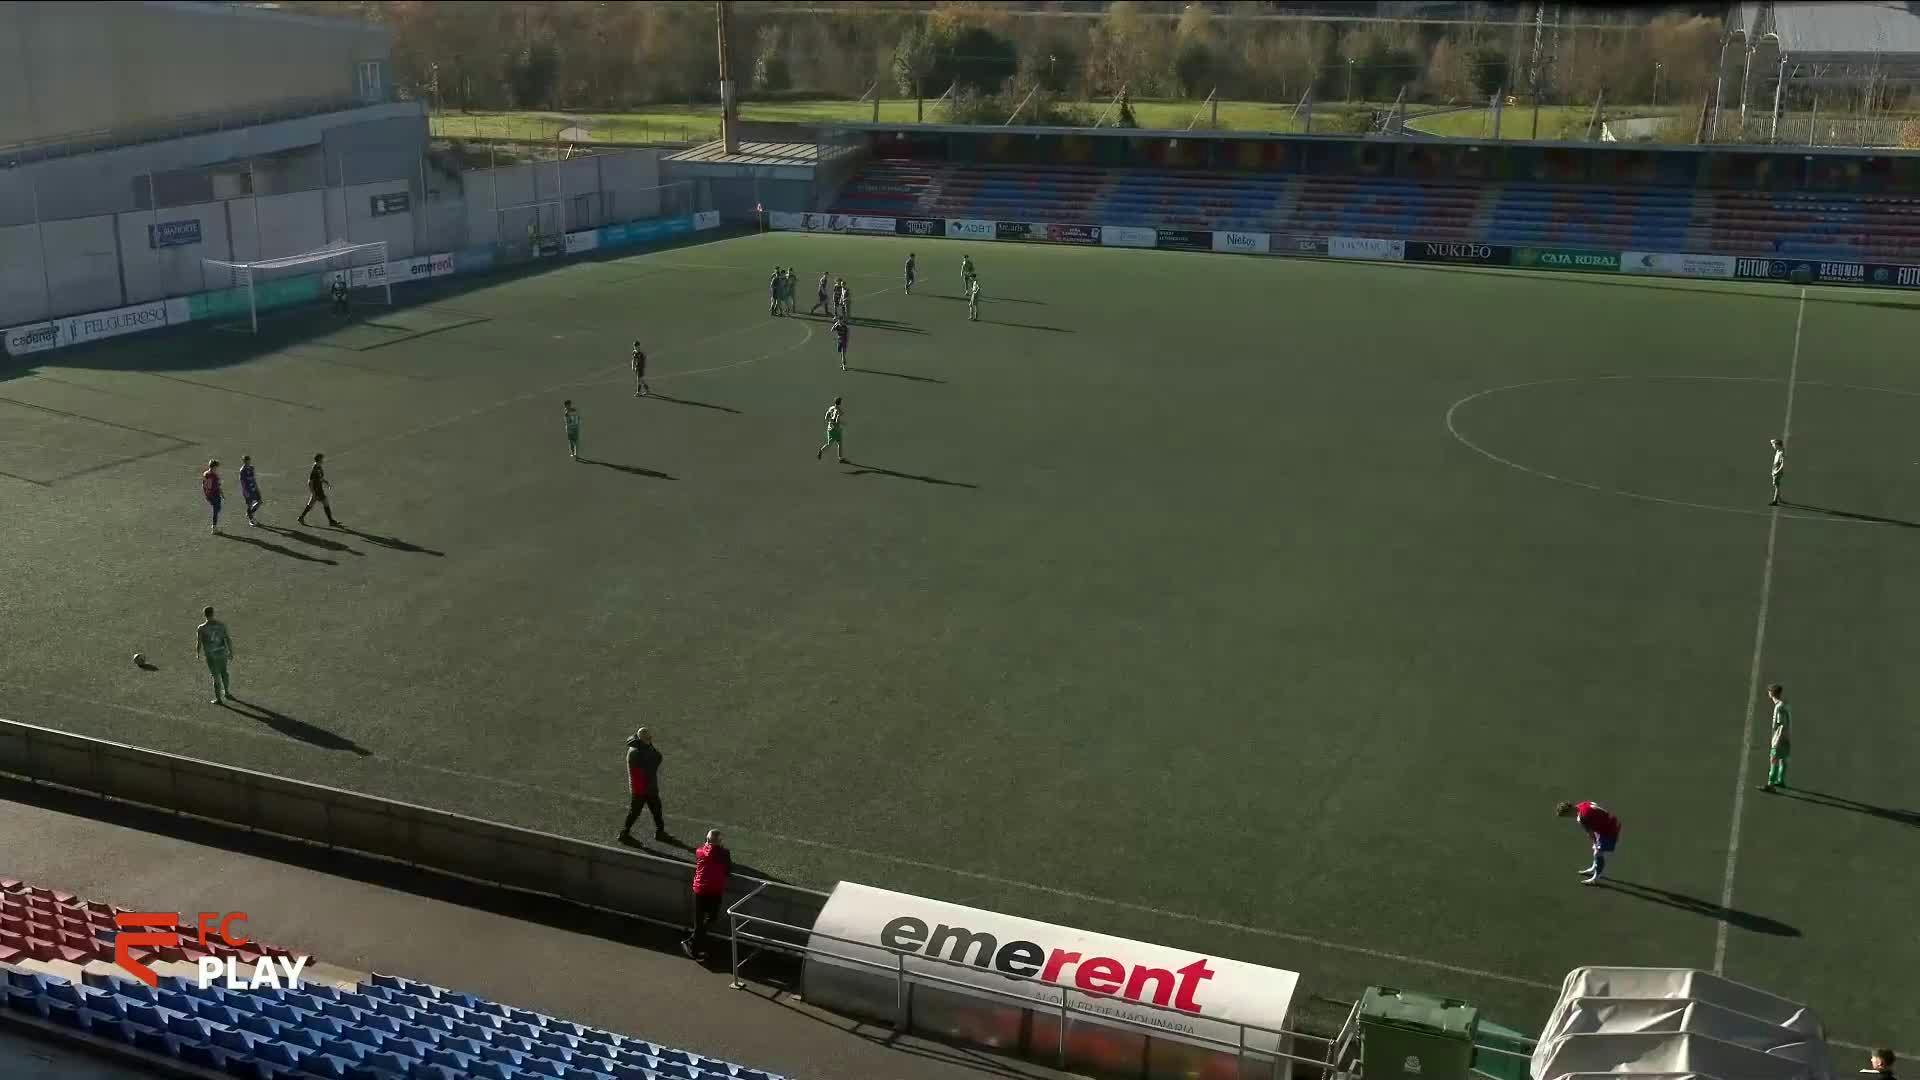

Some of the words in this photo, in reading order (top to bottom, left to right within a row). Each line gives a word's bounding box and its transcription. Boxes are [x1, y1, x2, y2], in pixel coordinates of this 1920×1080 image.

[1427, 243, 1491, 258] NUKLEO
[1542, 253, 1573, 264] CAJA
[1575, 255, 1619, 266] RURAL
[1820, 263, 1864, 277] SEGUNDA
[85, 308, 165, 335] FELGUEROSO
[880, 915, 1215, 1013] emerent
